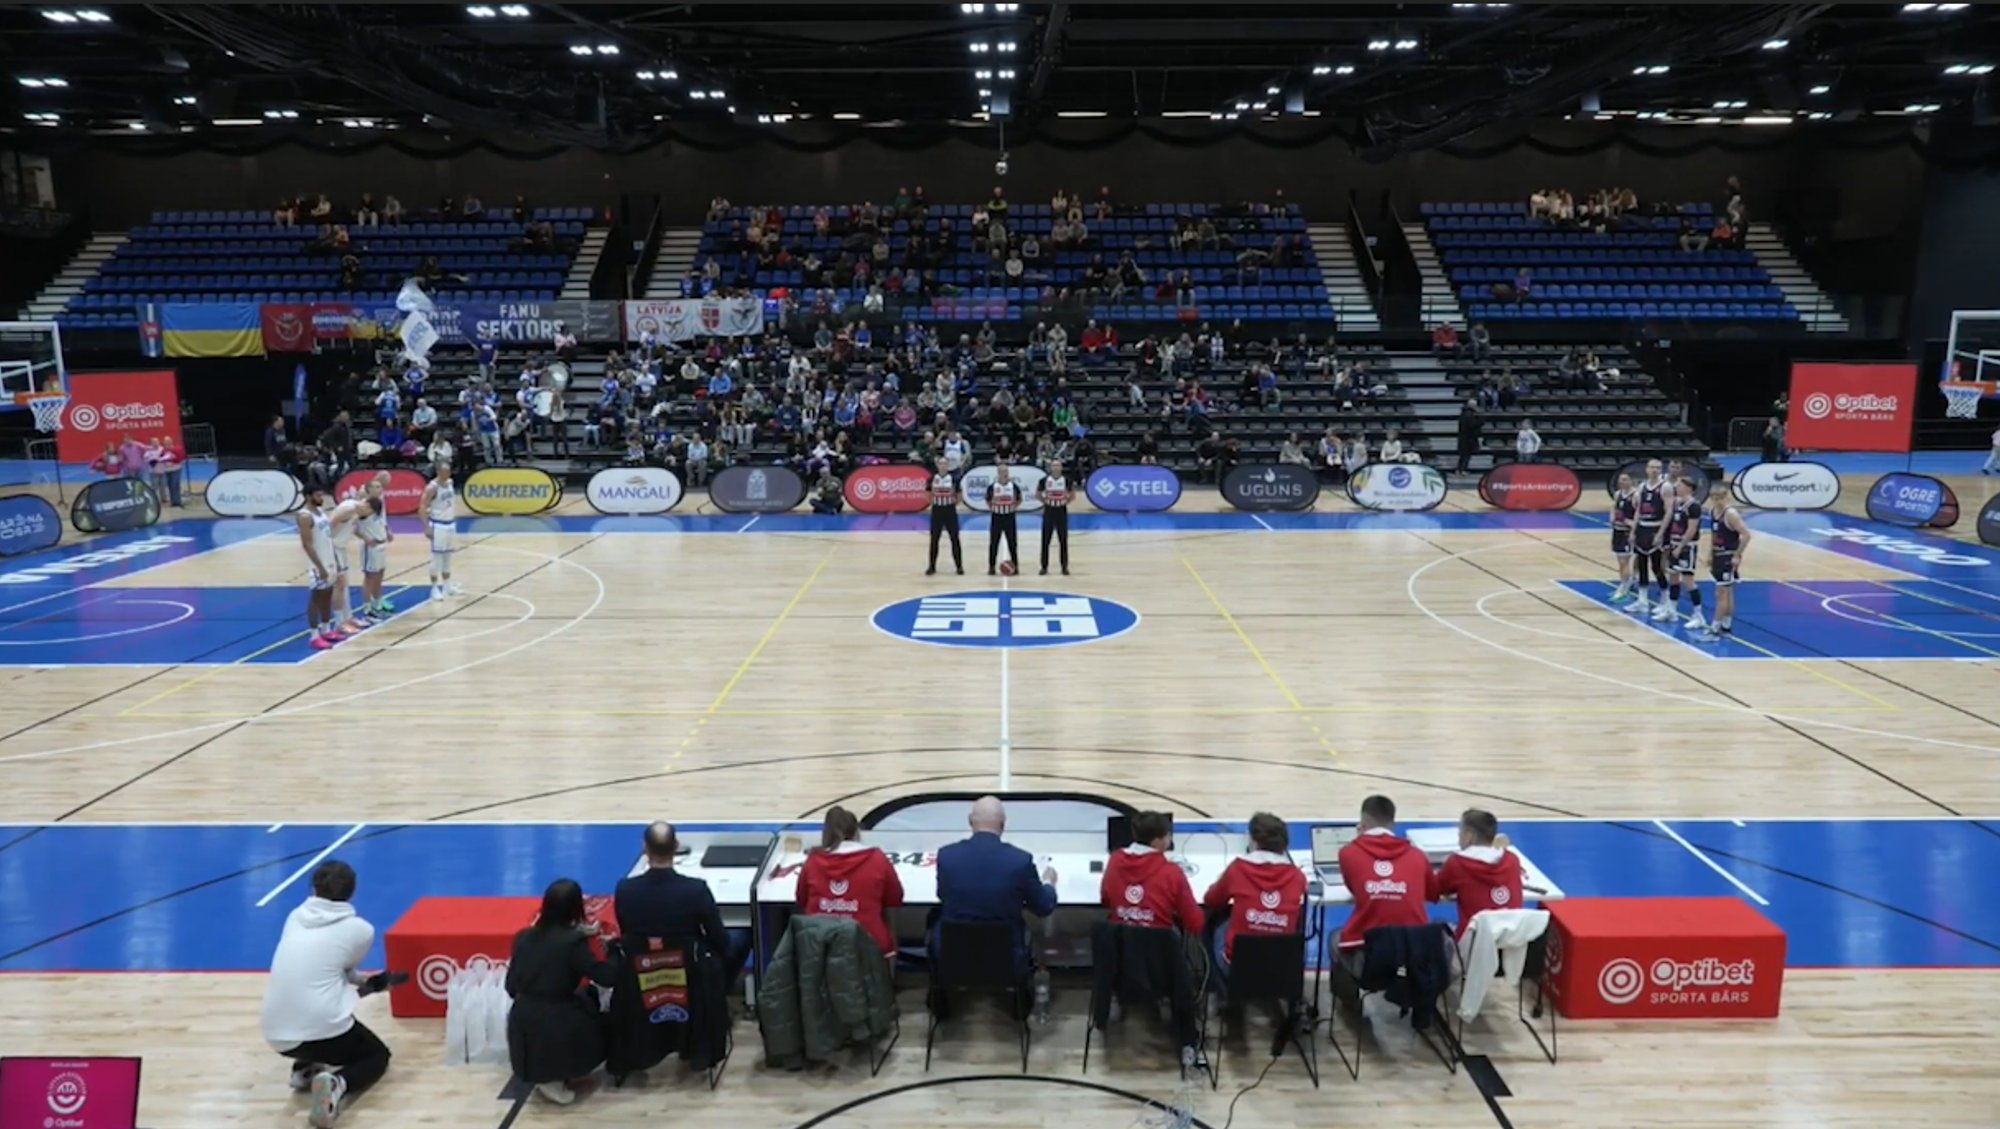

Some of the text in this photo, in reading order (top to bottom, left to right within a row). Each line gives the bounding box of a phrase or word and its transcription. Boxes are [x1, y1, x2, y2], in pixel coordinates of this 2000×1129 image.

[500, 303, 540, 318] FANU
[637, 305, 682, 315] LATVIJA
[475, 318, 563, 340] SEKTORS
[1834, 393, 1898, 412] Optibet
[102, 402, 165, 422] Optibet
[467, 483, 550, 498] RAMIRENT
[599, 486, 672, 499] MANGALI
[1118, 480, 1173, 496] STEEL
[1239, 483, 1303, 497] UGUNS
[1751, 482, 1831, 495] teamsport.lv
[1898, 485, 1938, 503] OGRE
[1364, 878, 1408, 895] Optibet
[1649, 957, 1756, 991] Optibet
[1650, 990, 1750, 1004] SPORTA BĀRS
